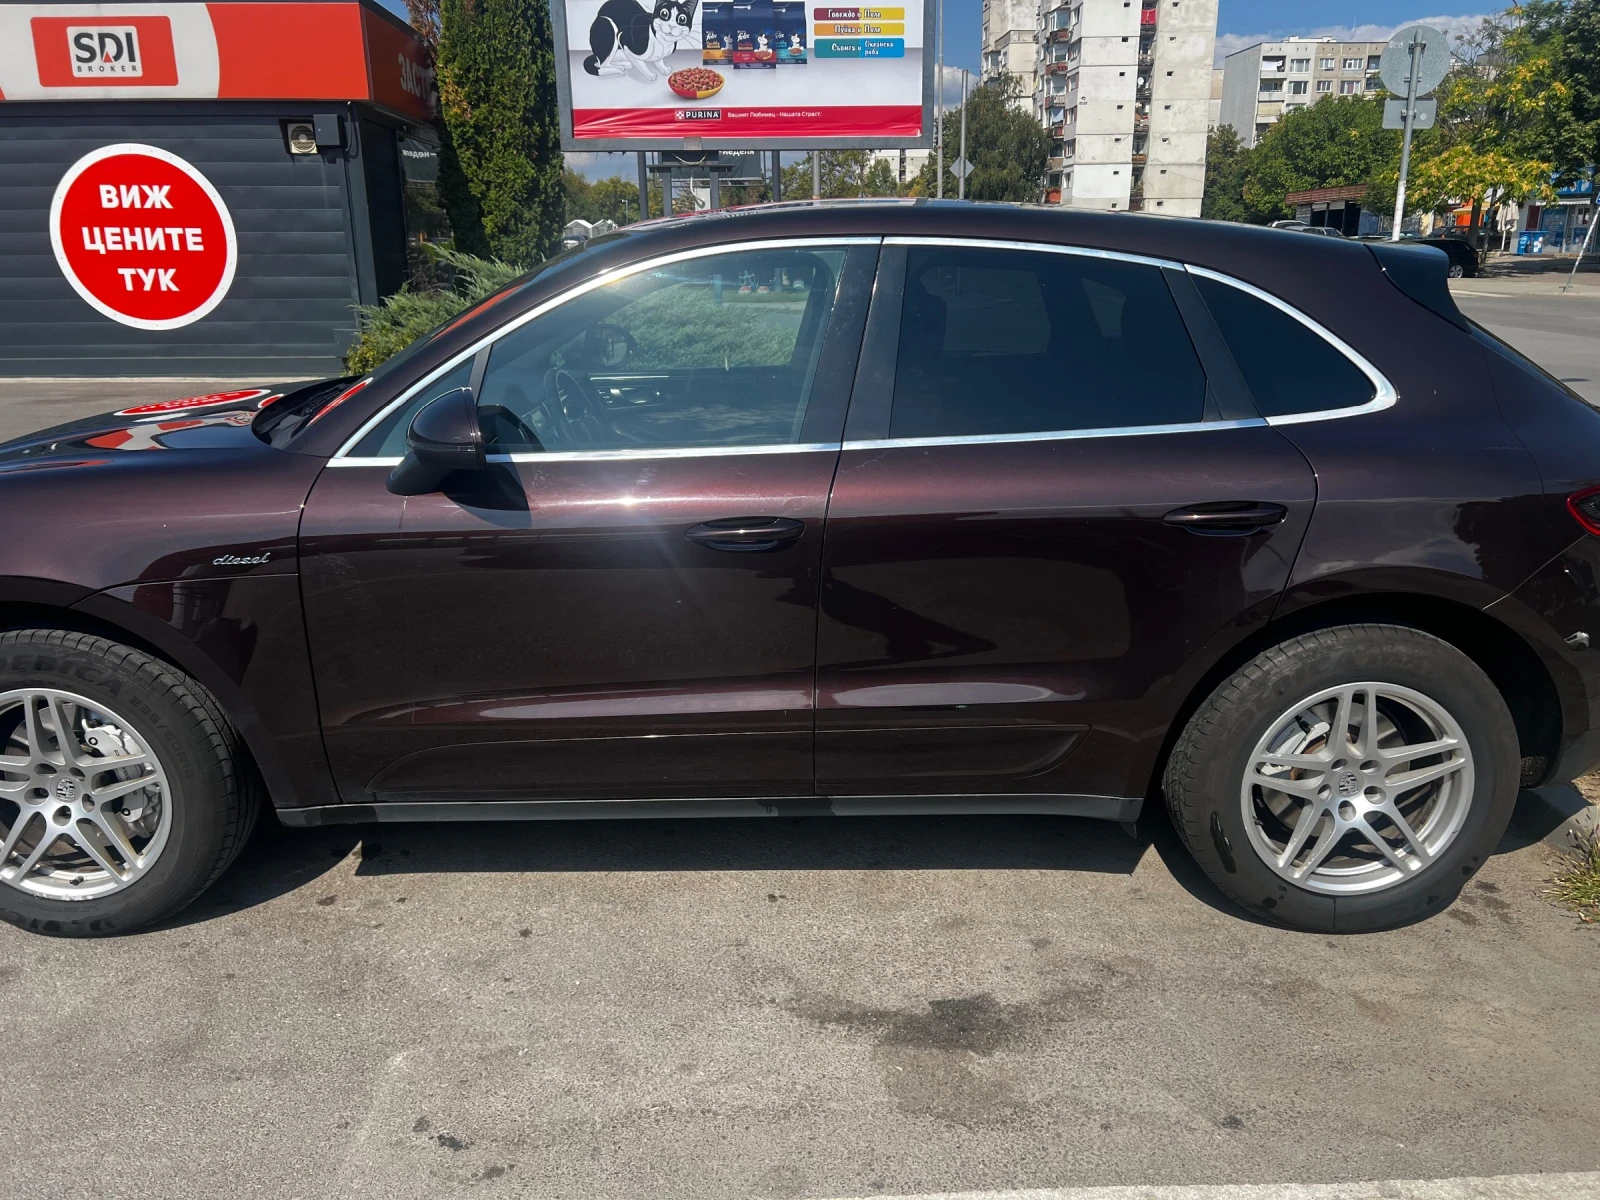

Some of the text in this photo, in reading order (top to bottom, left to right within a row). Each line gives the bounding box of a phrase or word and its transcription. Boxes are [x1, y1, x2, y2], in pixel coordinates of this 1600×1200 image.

[828, 9, 855, 18] Говеждо
[864, 9, 881, 18] Пиле
[834, 24, 856, 35] Пуйка
[864, 24, 881, 33] Пиле
[73, 32, 136, 63] SDI
[831, 43, 856, 52] Сьомга
[864, 40, 894, 48] Океанска
[864, 49, 879, 57] риба
[77, 65, 138, 73] BROKER
[686, 111, 719, 119] PURINA
[99, 184, 174, 209] ВИЖ
[81, 226, 205, 255] ЦЕНИТЕ
[117, 268, 180, 292] ТУК
[212, 552, 271, 566] diesel
